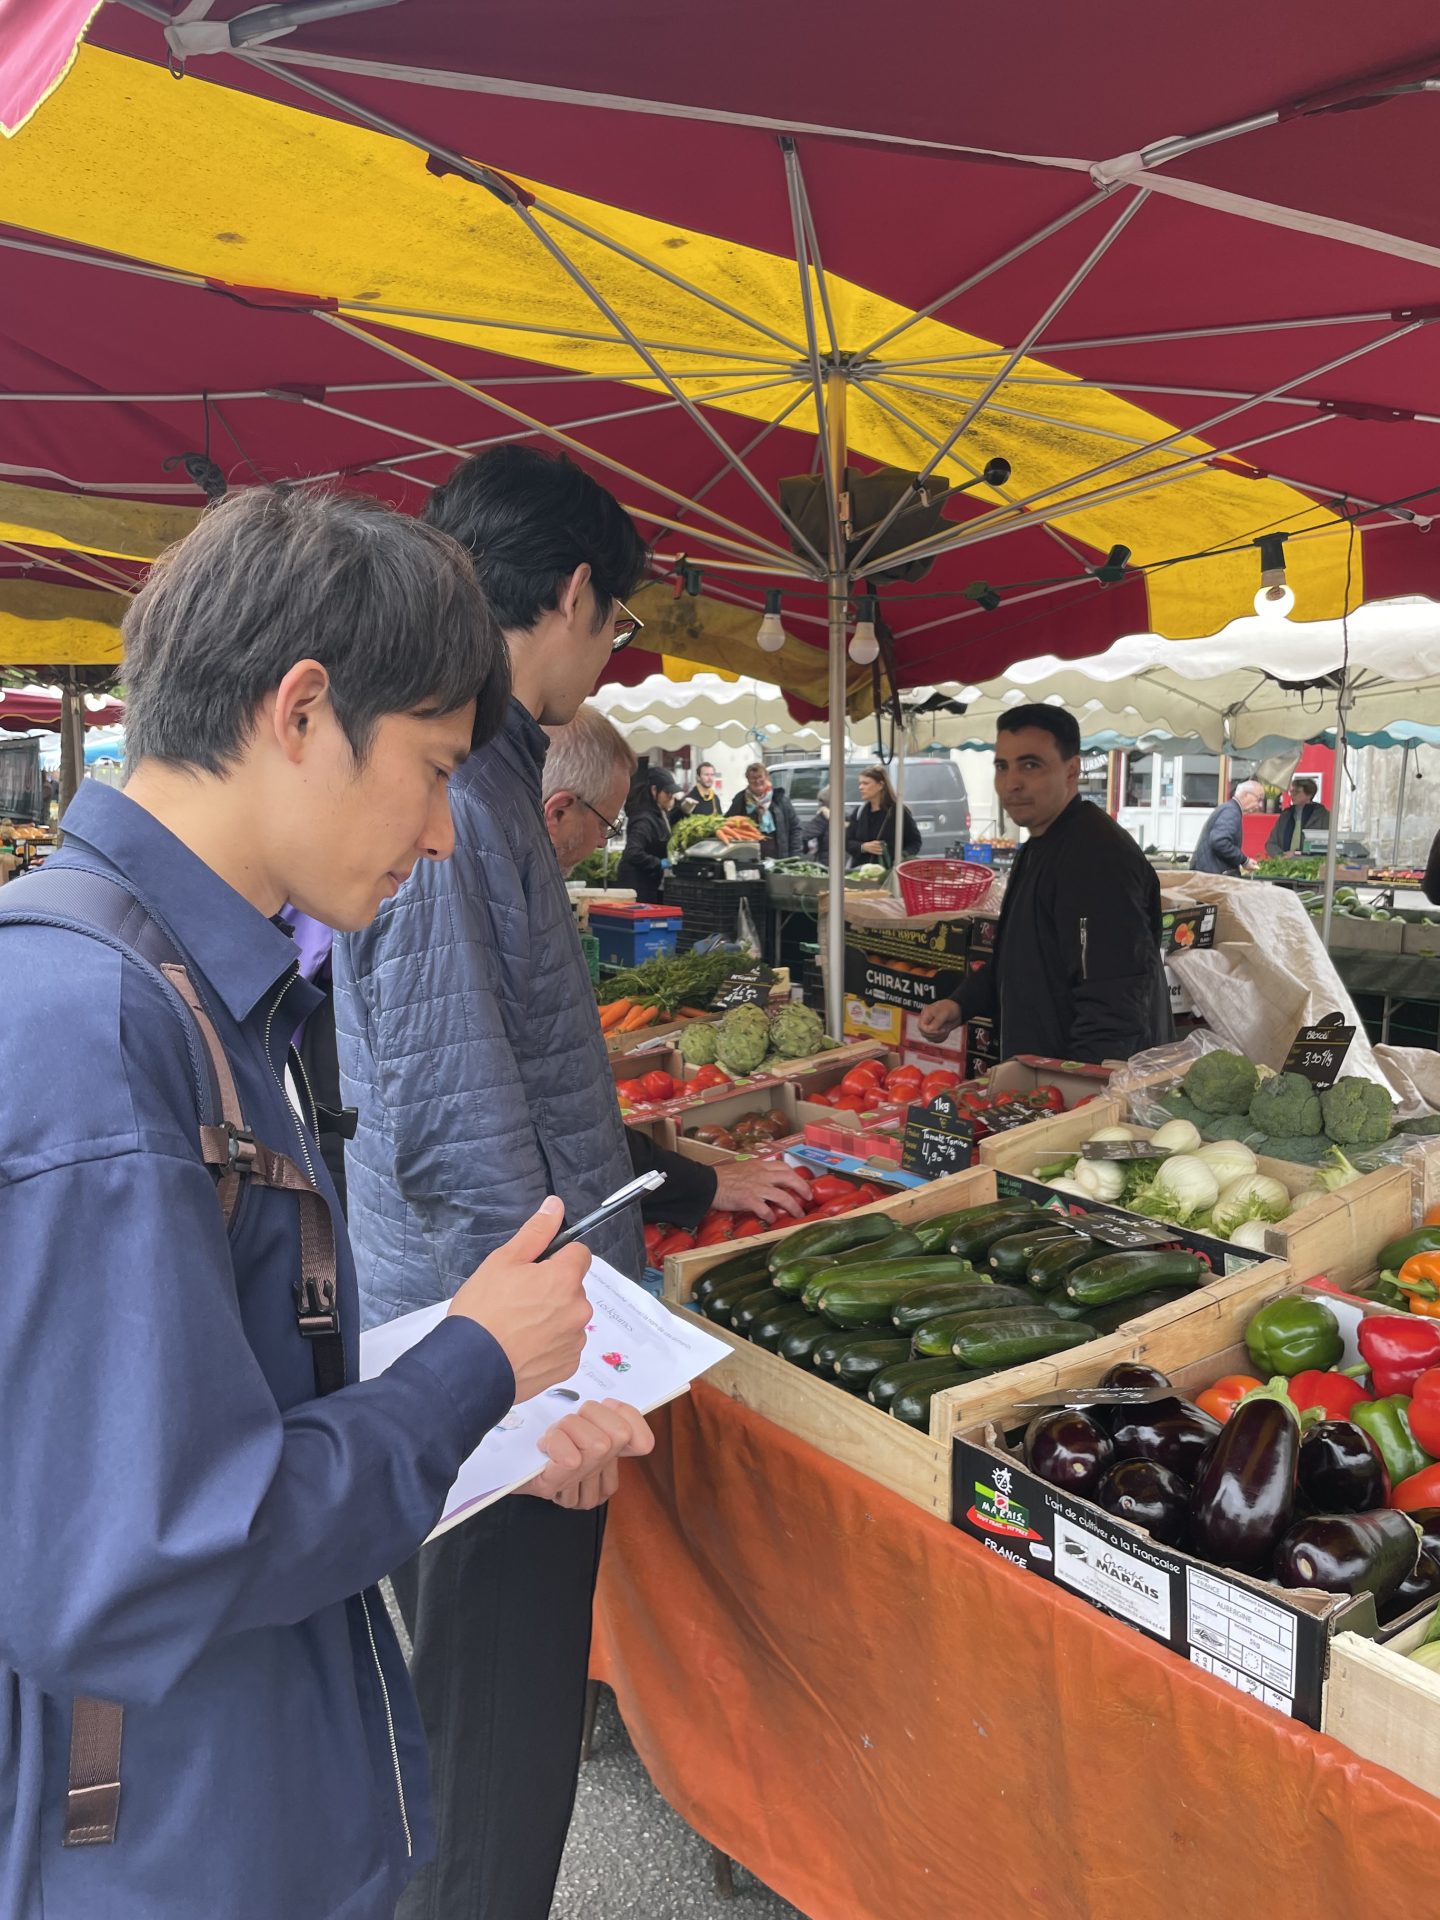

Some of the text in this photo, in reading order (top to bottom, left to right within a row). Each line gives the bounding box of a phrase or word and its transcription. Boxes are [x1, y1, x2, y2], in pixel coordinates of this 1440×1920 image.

[865, 988, 873, 996] LA
[866, 970, 936, 999] CHIRAZ N°1
[934, 1097, 951, 1113] 1kg
[982, 1501, 1022, 1521] MARAIS
[1045, 1494, 1181, 1574] L'art de cultiver à la Française
[984, 1538, 1028, 1569] FRANCE
[1096, 1559, 1159, 1600] MARAIS
[1216, 1601, 1252, 1623] AUBERGINE
